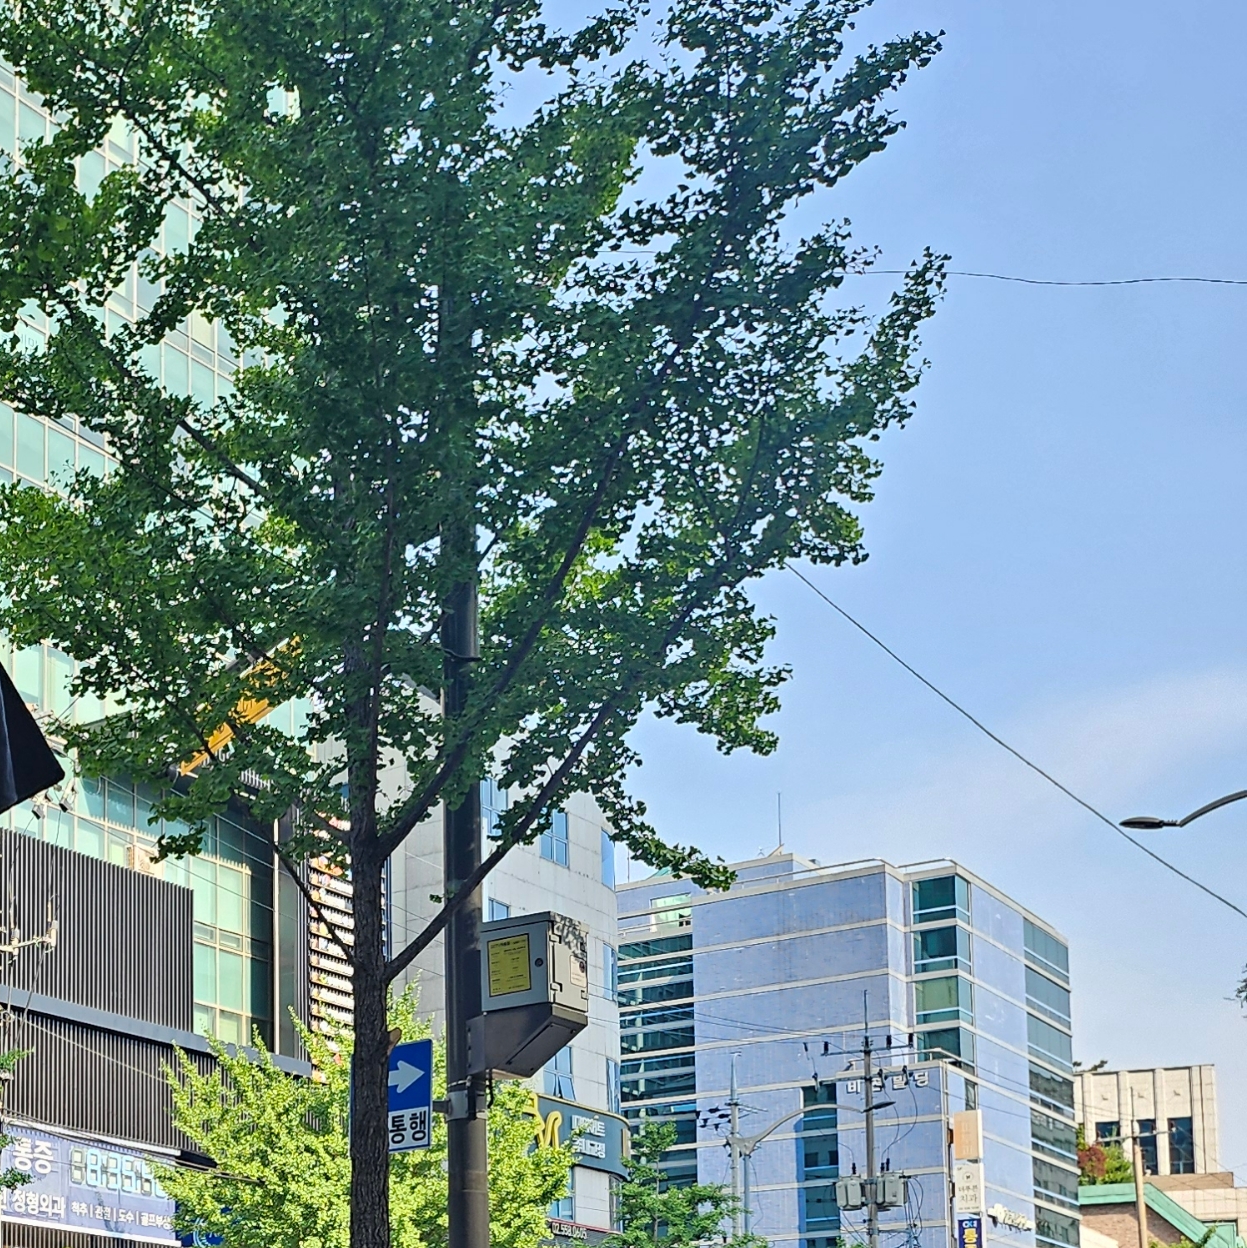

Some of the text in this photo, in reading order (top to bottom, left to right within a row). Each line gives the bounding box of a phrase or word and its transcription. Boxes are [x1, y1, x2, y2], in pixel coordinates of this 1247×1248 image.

[12, 1136, 54, 1174] 통증
[12, 1189, 66, 1219] 정형외과
[118, 1209, 134, 1223] 도수
